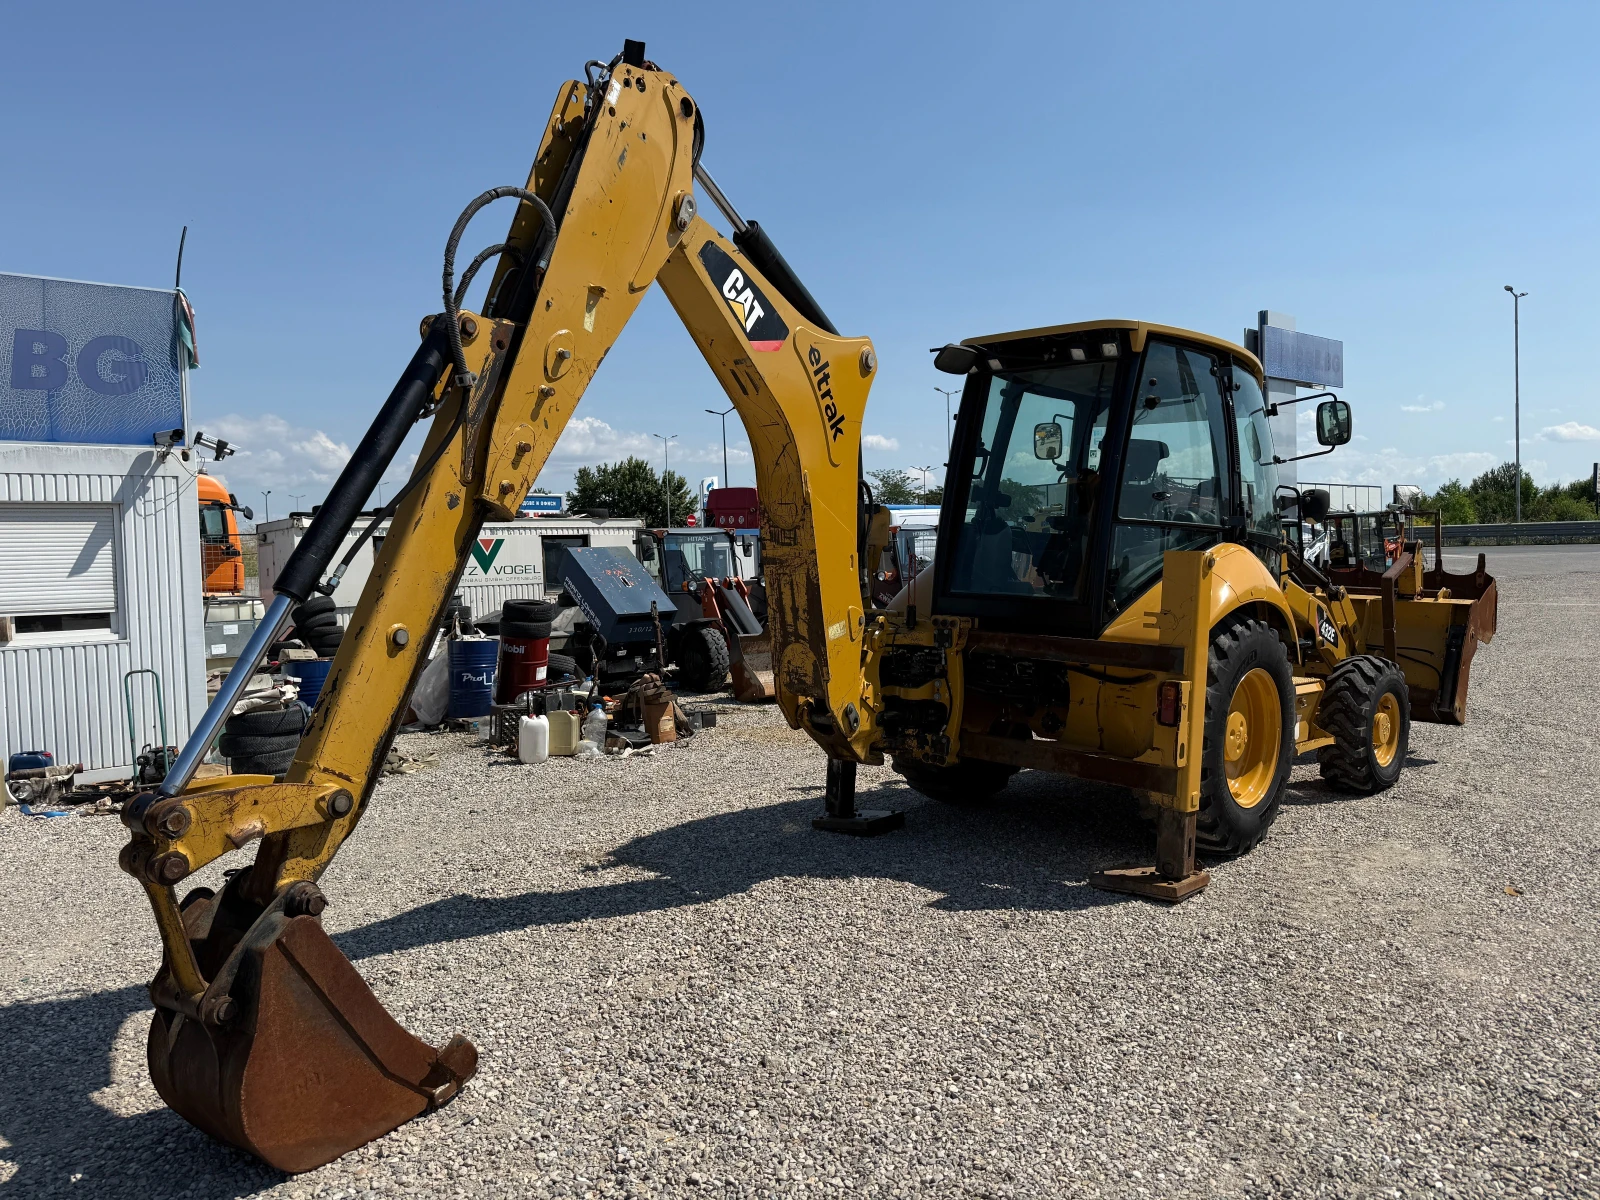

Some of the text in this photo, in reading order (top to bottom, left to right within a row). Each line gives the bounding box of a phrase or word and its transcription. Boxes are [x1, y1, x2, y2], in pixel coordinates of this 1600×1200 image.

[722, 268, 764, 333] CAT
[11, 329, 148, 396] BG
[808, 344, 846, 443] eltrak
[493, 564, 541, 575] VOGEL
[502, 643, 525, 654] Mobil
[1321, 621, 1335, 643] 432E
